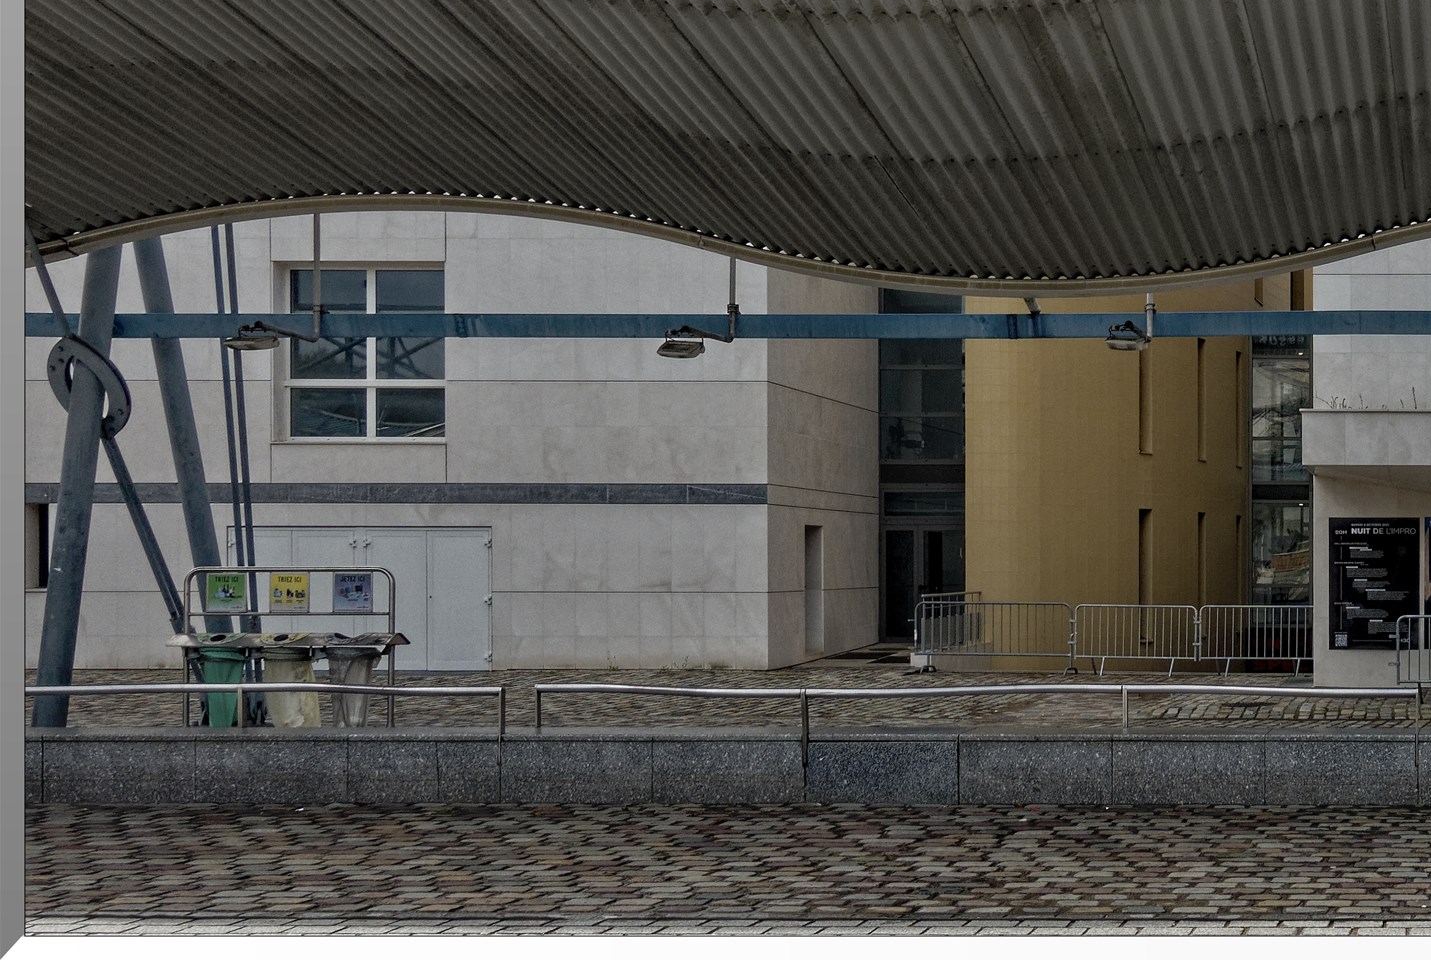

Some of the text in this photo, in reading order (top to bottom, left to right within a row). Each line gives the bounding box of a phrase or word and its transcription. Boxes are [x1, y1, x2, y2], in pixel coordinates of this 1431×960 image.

[1351, 527, 1371, 535] NUIT
[1372, 527, 1384, 535] DE
[1385, 527, 1417, 535] L'IMPRO
